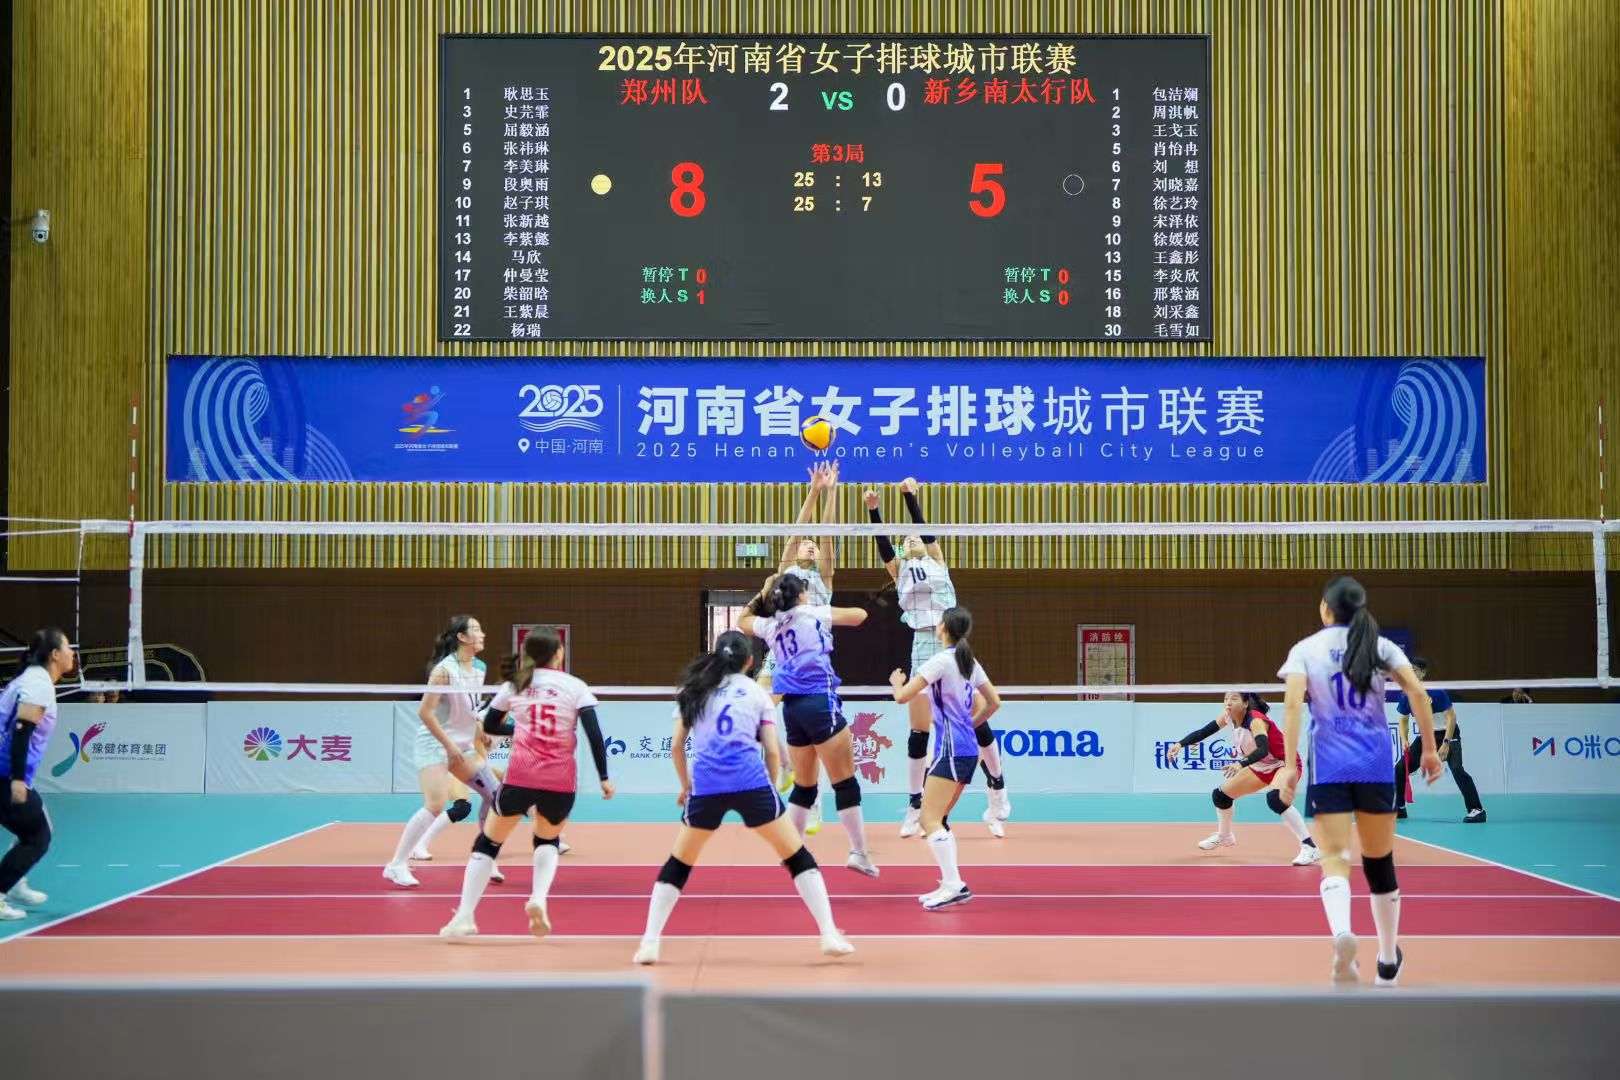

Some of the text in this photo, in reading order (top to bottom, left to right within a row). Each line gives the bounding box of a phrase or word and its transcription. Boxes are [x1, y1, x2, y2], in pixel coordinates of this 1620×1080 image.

[598, 41, 1077, 75] 2025年河南省女子排球城市联赛
[463, 87, 549, 101] 1 耿思玉
[620, 77, 1097, 112] 郑州队 2 VS 0 新乡南太行队
[1112, 87, 1120, 101] 1
[462, 105, 472, 118] 3
[1111, 105, 1121, 119] 2
[463, 123, 549, 137] 5 屈毅涵
[1111, 123, 1198, 137] 3 王戈玉
[462, 141, 472, 155] 6
[811, 144, 865, 164] 第3局
[1111, 141, 1198, 156] 5 肖怡冉
[462, 159, 549, 173] 7 李美琳
[1111, 160, 1121, 173] 6
[462, 177, 549, 192] 9 段奥雨
[794, 172, 815, 187] 25
[862, 172, 882, 187] 13
[1111, 178, 1198, 192] 7 刘晓嘉
[669, 161, 707, 217] 8
[969, 163, 1007, 218] 5
[454, 196, 549, 210] 10 赵子琪
[794, 196, 815, 212] 25
[861, 196, 873, 212] 7
[1111, 196, 1199, 210] 8 徐艺玲
[455, 214, 549, 228] 11 张新越
[1111, 214, 1198, 228] 9 宋泽依
[454, 232, 472, 245] 13
[1104, 232, 1199, 246] 10 徐媛媛
[454, 250, 541, 264] 14 马欣
[1104, 250, 1199, 264] 13 王鑫彤
[454, 268, 548, 283] 17 仲曼莹
[641, 266, 673, 284] 暂停
[696, 268, 707, 285] 0
[1004, 266, 1036, 284] 暂停
[1058, 268, 1070, 285] 0
[1104, 268, 1199, 283] 15 李炎欣
[453, 286, 472, 300] 20
[641, 287, 673, 305] 换人
[696, 289, 705, 305] 1
[1003, 287, 1035, 305] 换人
[1058, 289, 1070, 306] 0
[1104, 286, 1199, 301] 16 邢紫涵
[453, 304, 548, 318] 21 王紫晨
[1104, 304, 1199, 319] 18 刘采鑫
[453, 323, 541, 338] 22 杨瑞
[1104, 323, 1199, 338] 30 毛雪如
[637, 385, 1265, 437] 河南省女子排球城市联赛
[535, 438, 603, 455] 中国·河南
[637, 443, 697, 457] 2025
[715, 443, 794, 457] Henan
[946, 442, 1083, 461] Volleyball
[1101, 443, 1153, 461] City
[1171, 443, 1264, 461] League
[775, 629, 798, 660] 13
[527, 703, 556, 736] 15
[716, 704, 733, 736] 6
[287, 734, 352, 761] 大麦
